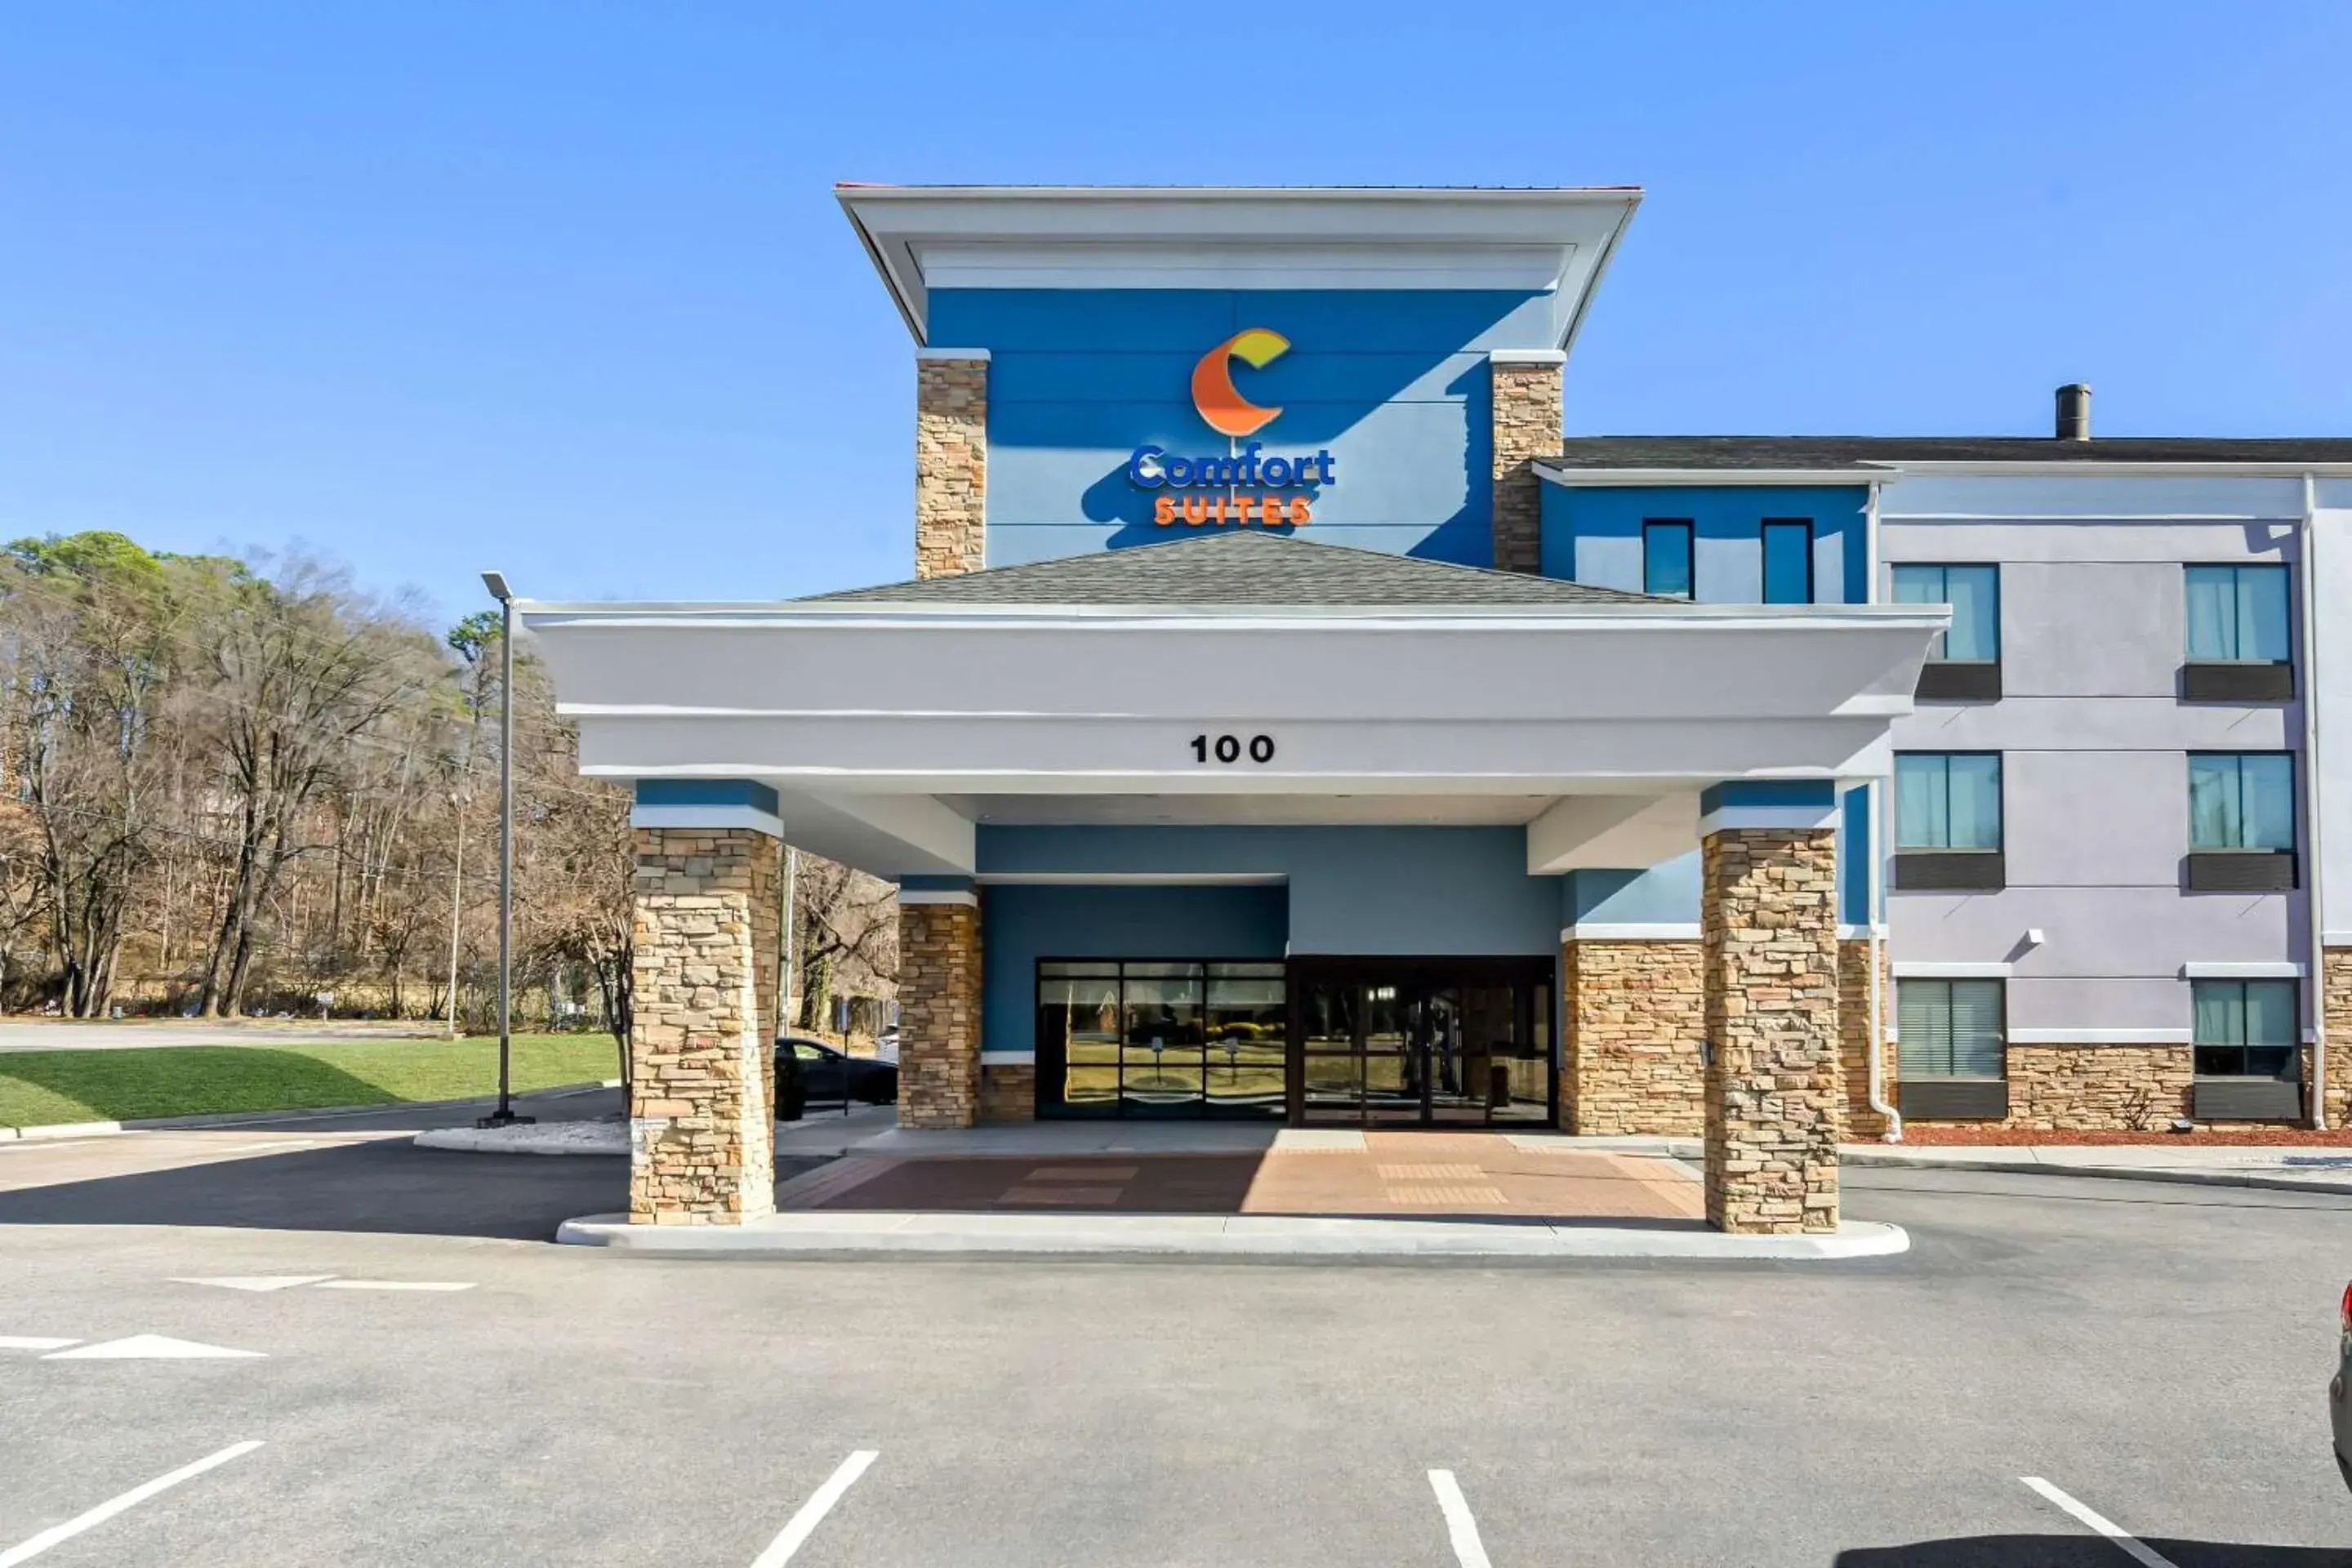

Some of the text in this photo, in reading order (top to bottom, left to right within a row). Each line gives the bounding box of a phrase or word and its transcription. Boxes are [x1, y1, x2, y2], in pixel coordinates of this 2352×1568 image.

[1130, 442, 1335, 488] Comfort
[1154, 495, 1312, 525] SUITES
[1191, 735, 1275, 763] 100
